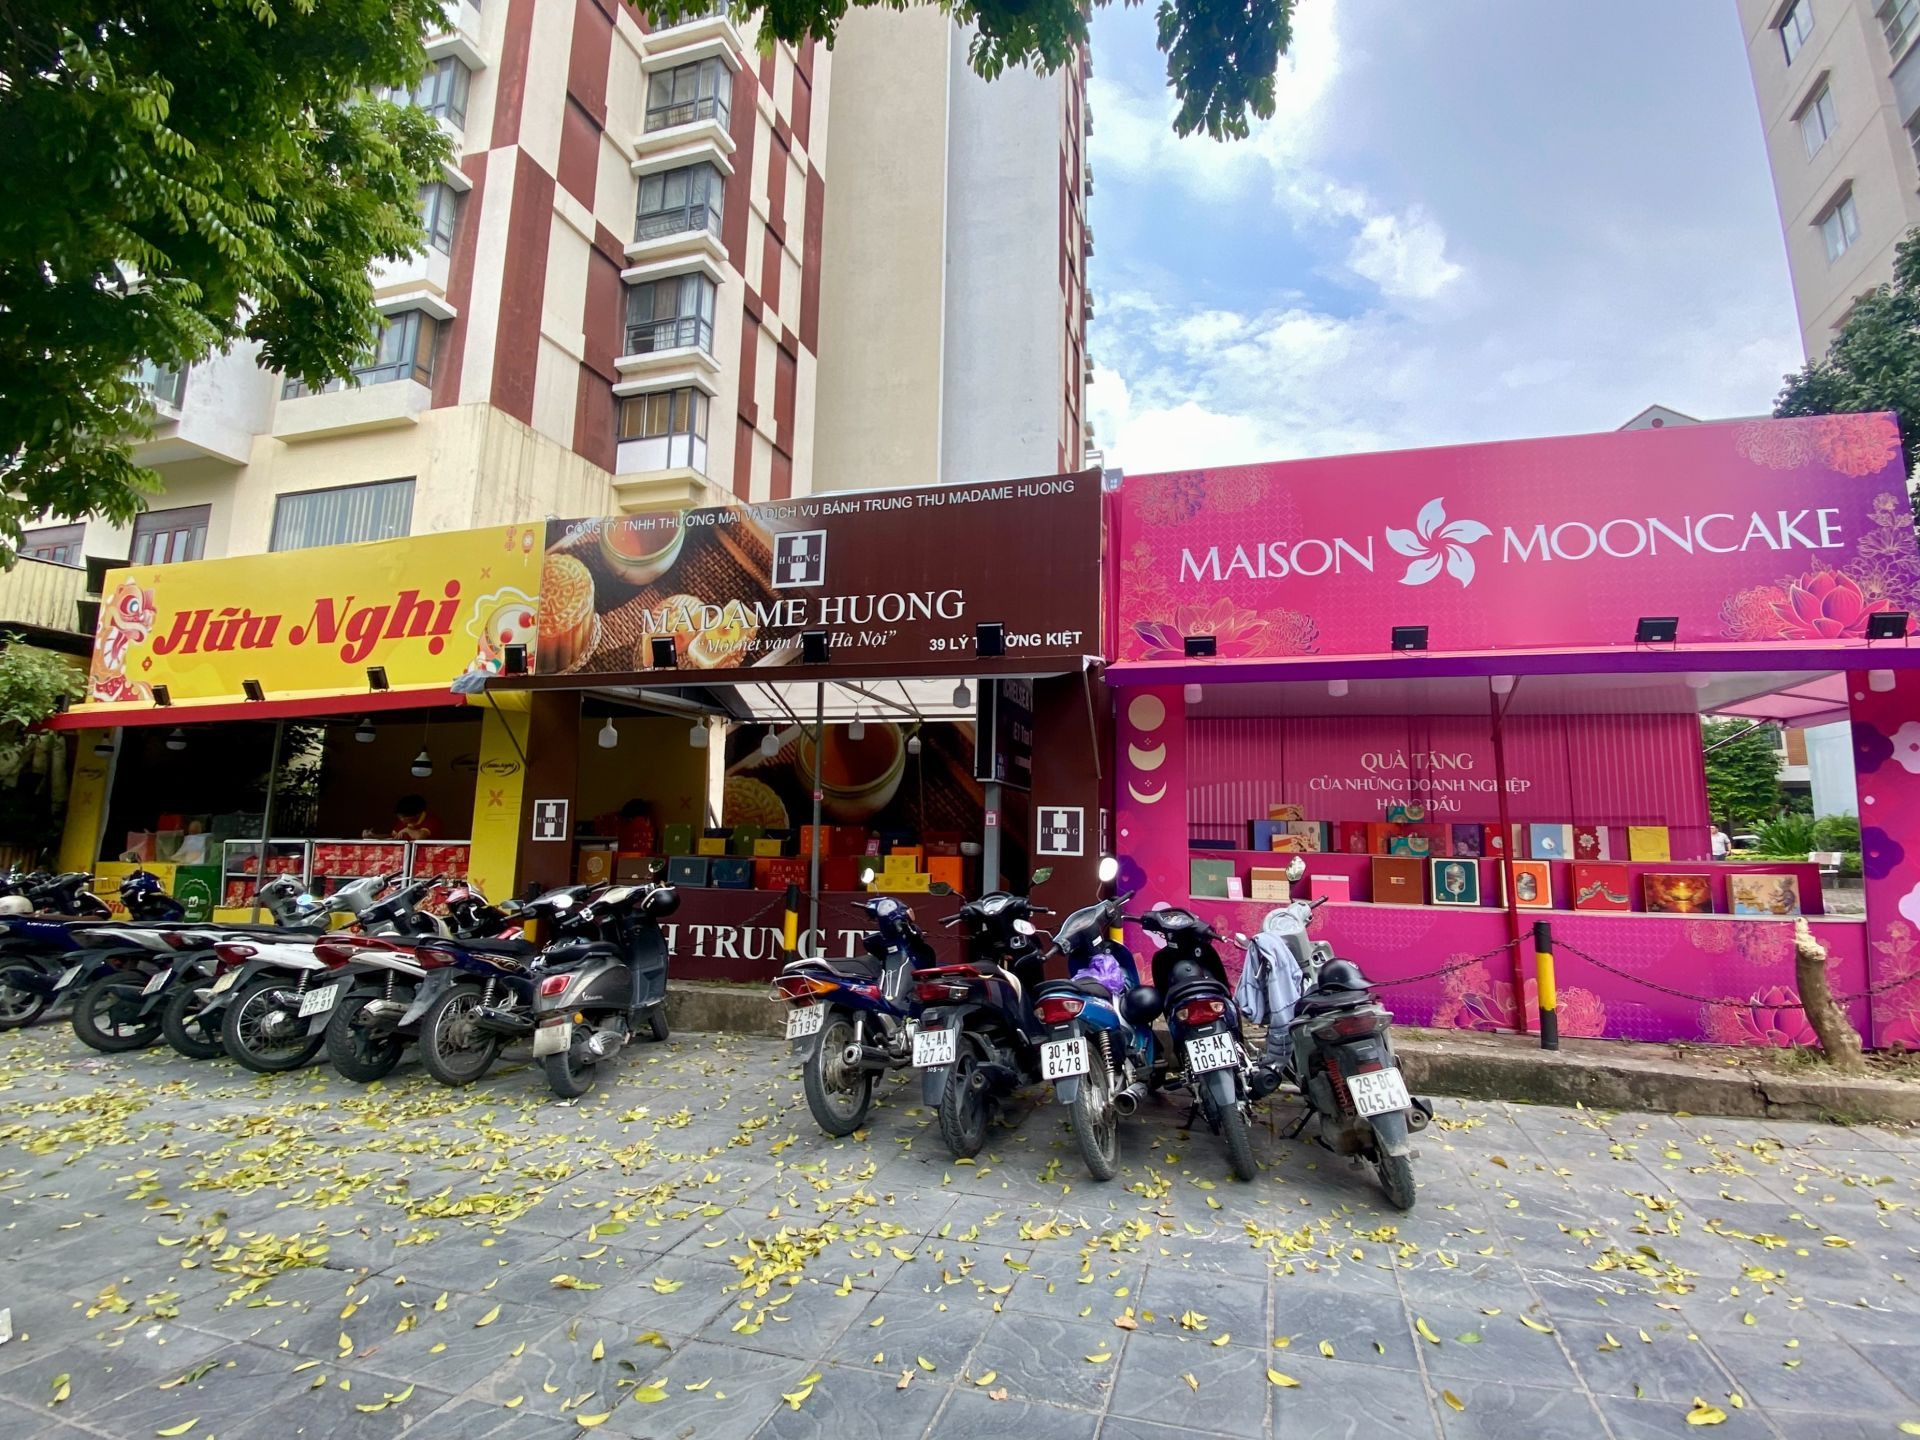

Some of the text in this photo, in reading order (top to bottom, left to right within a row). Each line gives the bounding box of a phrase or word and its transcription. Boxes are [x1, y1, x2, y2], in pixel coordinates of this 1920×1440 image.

[565, 521, 600, 536] CÔNG
[604, 520, 618, 533] TY
[623, 518, 656, 532] TNHH
[659, 512, 715, 530] THƯƠNG
[718, 510, 741, 527] MẠI
[765, 504, 797, 521] DỊCH
[800, 503, 819, 519] VỤ
[823, 500, 860, 515] BÁNH
[863, 495, 913, 512] TRUNG
[916, 493, 946, 507] THU
[949, 486, 1014, 504] MADAME
[1017, 479, 1075, 498] HUONG
[1178, 507, 1846, 583] MAISON MOONCAKE
[778, 553, 820, 565] HUONG
[152, 578, 461, 665] Hữu Nghị
[641, 589, 967, 636] MADAME HUONG
[767, 637, 791, 651] văn
[829, 631, 853, 648] Hà
[929, 630, 1083, 651] 39 LÝ TỜNG KIỆT
[1360, 749, 1475, 774] QUÀ TẶNG
[1309, 774, 1344, 791] CỦA
[1345, 775, 1403, 792] NHỮNG
[1407, 778, 1465, 792] DOANH
[1042, 826, 1079, 836] HUONG
[688, 923, 828, 961] TRUNG
[791, 1019, 818, 1036] 0199
[920, 1031, 948, 1048] 24-AA
[1192, 1034, 1227, 1055] 35-AK
[1049, 1057, 1082, 1076] 8478
[1194, 1049, 1236, 1071] 109.42
[1355, 1072, 1394, 1095] 29-BC
[1358, 1088, 1406, 1114] 045.41
